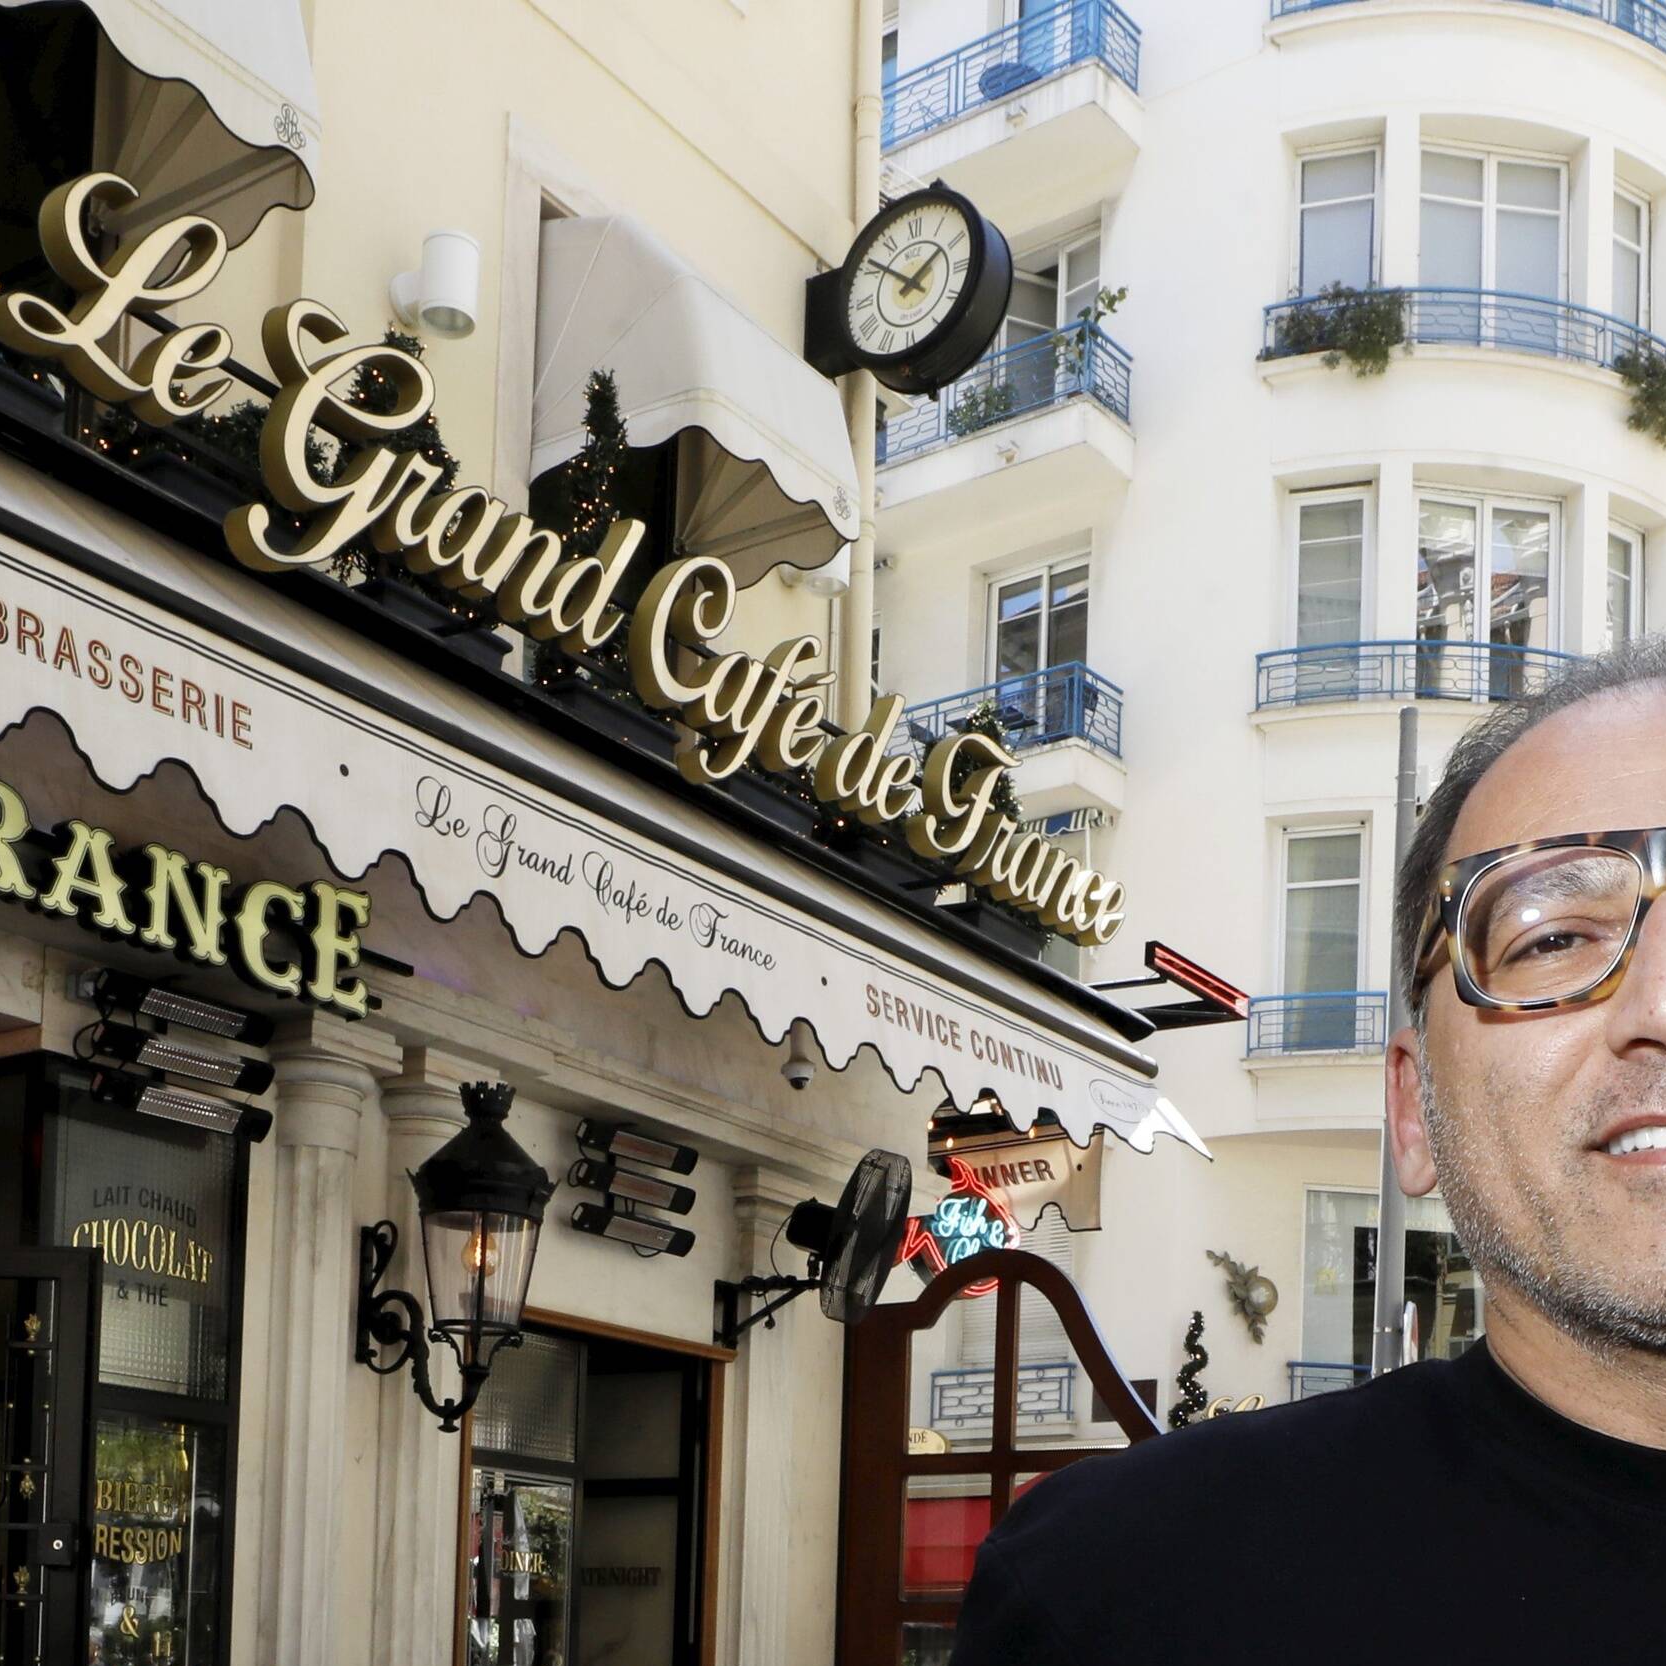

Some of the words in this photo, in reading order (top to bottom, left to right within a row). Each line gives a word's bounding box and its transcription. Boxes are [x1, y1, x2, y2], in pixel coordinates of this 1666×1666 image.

[225, 297, 646, 655] Grand
[631, 555, 836, 786] Café
[816, 694, 922, 825] de
[907, 733, 1126, 946] France
[415, 776, 469, 842] Le
[476, 805, 575, 886] Grand
[581, 851, 652, 919] Café
[656, 893, 684, 931] de
[688, 903, 776, 971] France
[865, 983, 962, 1052] SERVICE
[970, 1029, 1063, 1091] CONTINU
[973, 1159, 1055, 1190] INNER
[93, 1186, 132, 1209] LAIT
[138, 1188, 197, 1228] CHAUD
[938, 1198, 988, 1238] Fish
[989, 1219, 1006, 1250] &
[72, 1218, 213, 1283] CHOCOLAT
[117, 1280, 129, 1300] &
[137, 1281, 169, 1307] THÉ
[94, 1523, 183, 1565] RESSION
[120, 1605, 140, 1638] &
